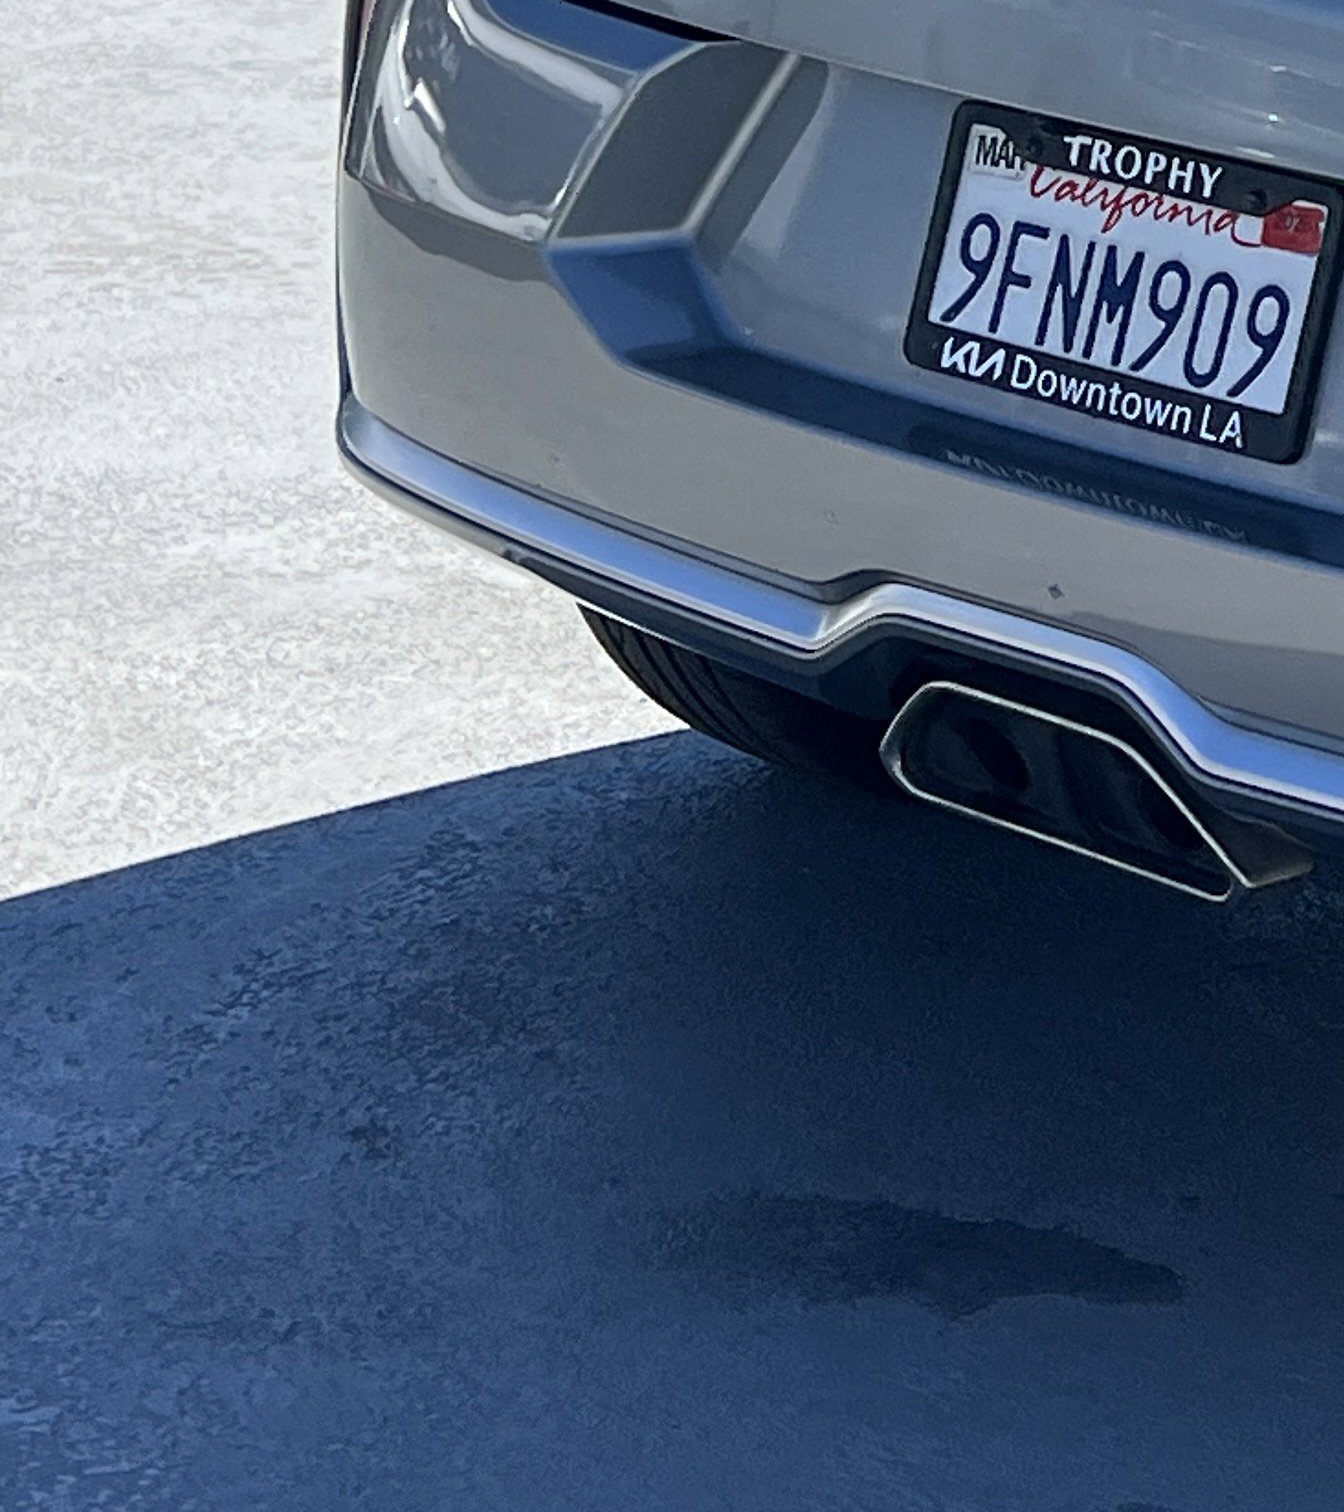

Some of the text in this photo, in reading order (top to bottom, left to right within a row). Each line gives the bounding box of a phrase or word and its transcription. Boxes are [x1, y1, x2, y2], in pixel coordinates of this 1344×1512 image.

[975, 134, 1025, 171] MA
[1063, 134, 1224, 199] TROPHY
[1030, 165, 1262, 247] California
[940, 213, 1290, 398] 9FNM909
[1010, 354, 1192, 434] Downtown
[1199, 394, 1243, 448] LA
